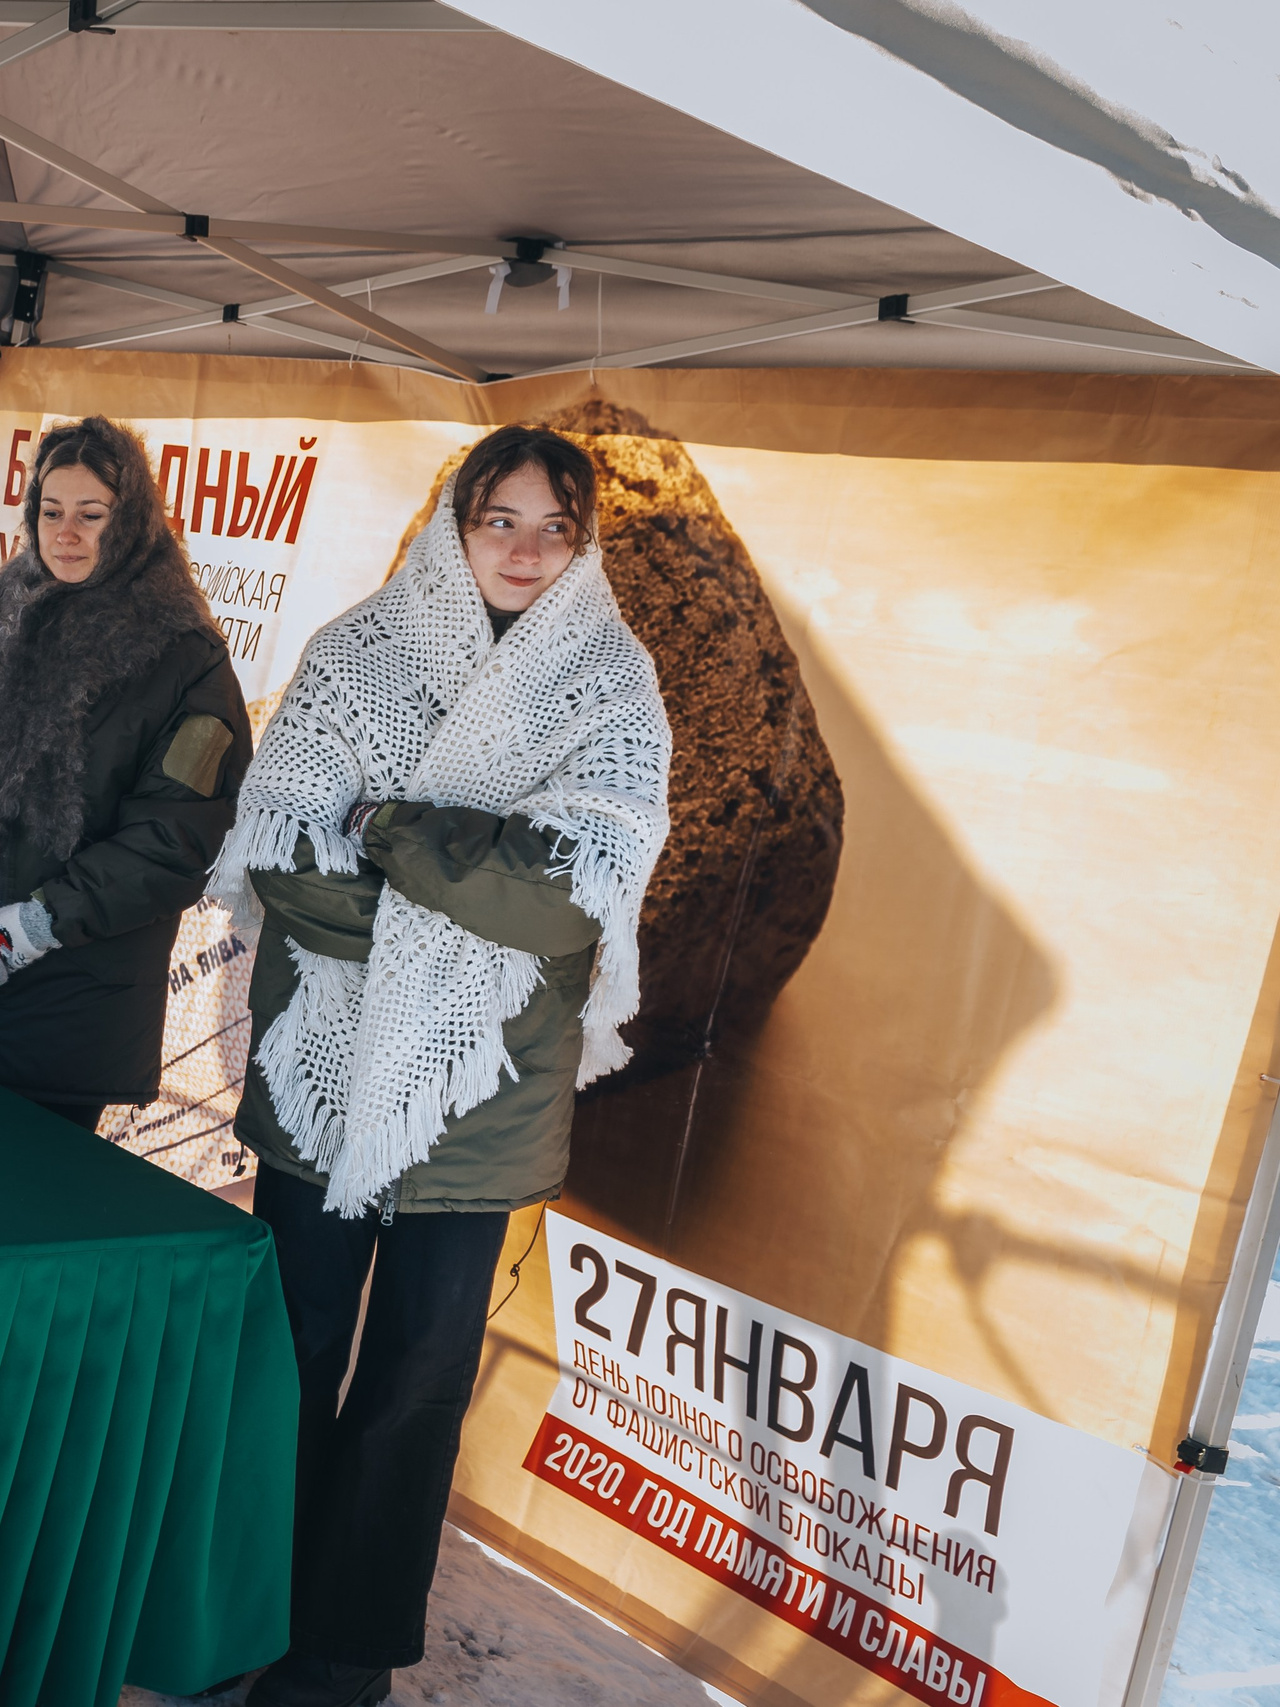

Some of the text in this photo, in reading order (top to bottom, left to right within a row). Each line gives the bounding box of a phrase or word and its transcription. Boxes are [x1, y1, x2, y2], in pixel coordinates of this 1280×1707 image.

[3, 428, 318, 544] БДНЫЙ
[196, 933, 248, 977] ЯНВА
[544, 1433, 986, 1707] 2020. ГОД ПАМЯТИ И СЛАВЫ
[573, 1377, 924, 1605] ОТ ФАШИСТСКОЙ БЛОКАДЫ
[574, 1340, 996, 1593] ДЕНЬ ПОЛНОГО ОСВОБОЖДЕНИЯ
